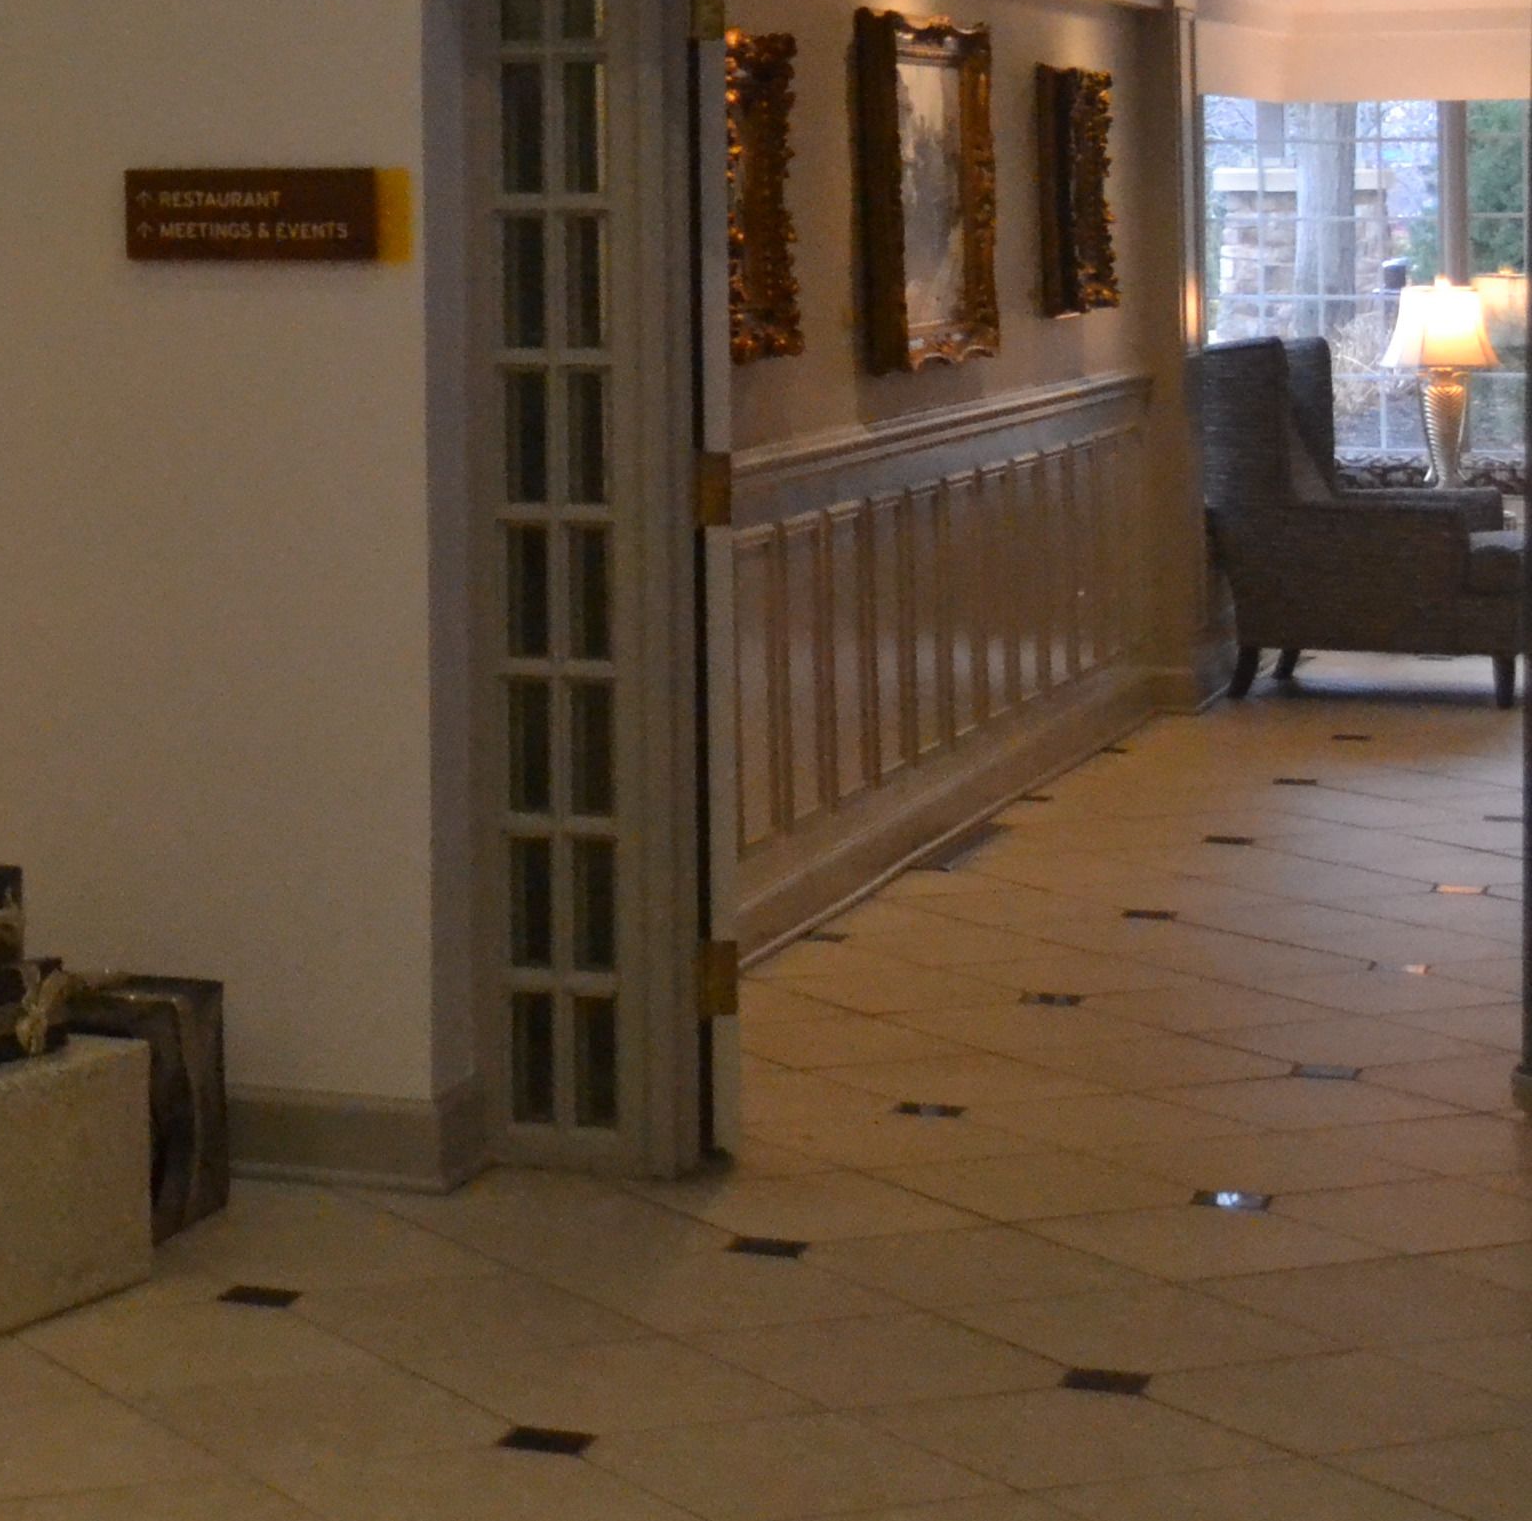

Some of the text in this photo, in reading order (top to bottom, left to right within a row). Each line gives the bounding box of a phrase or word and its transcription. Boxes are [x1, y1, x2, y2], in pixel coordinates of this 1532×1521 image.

[158, 190, 281, 208] RESTAURANT
[158, 221, 348, 239] MEETINGS & EVENTS
